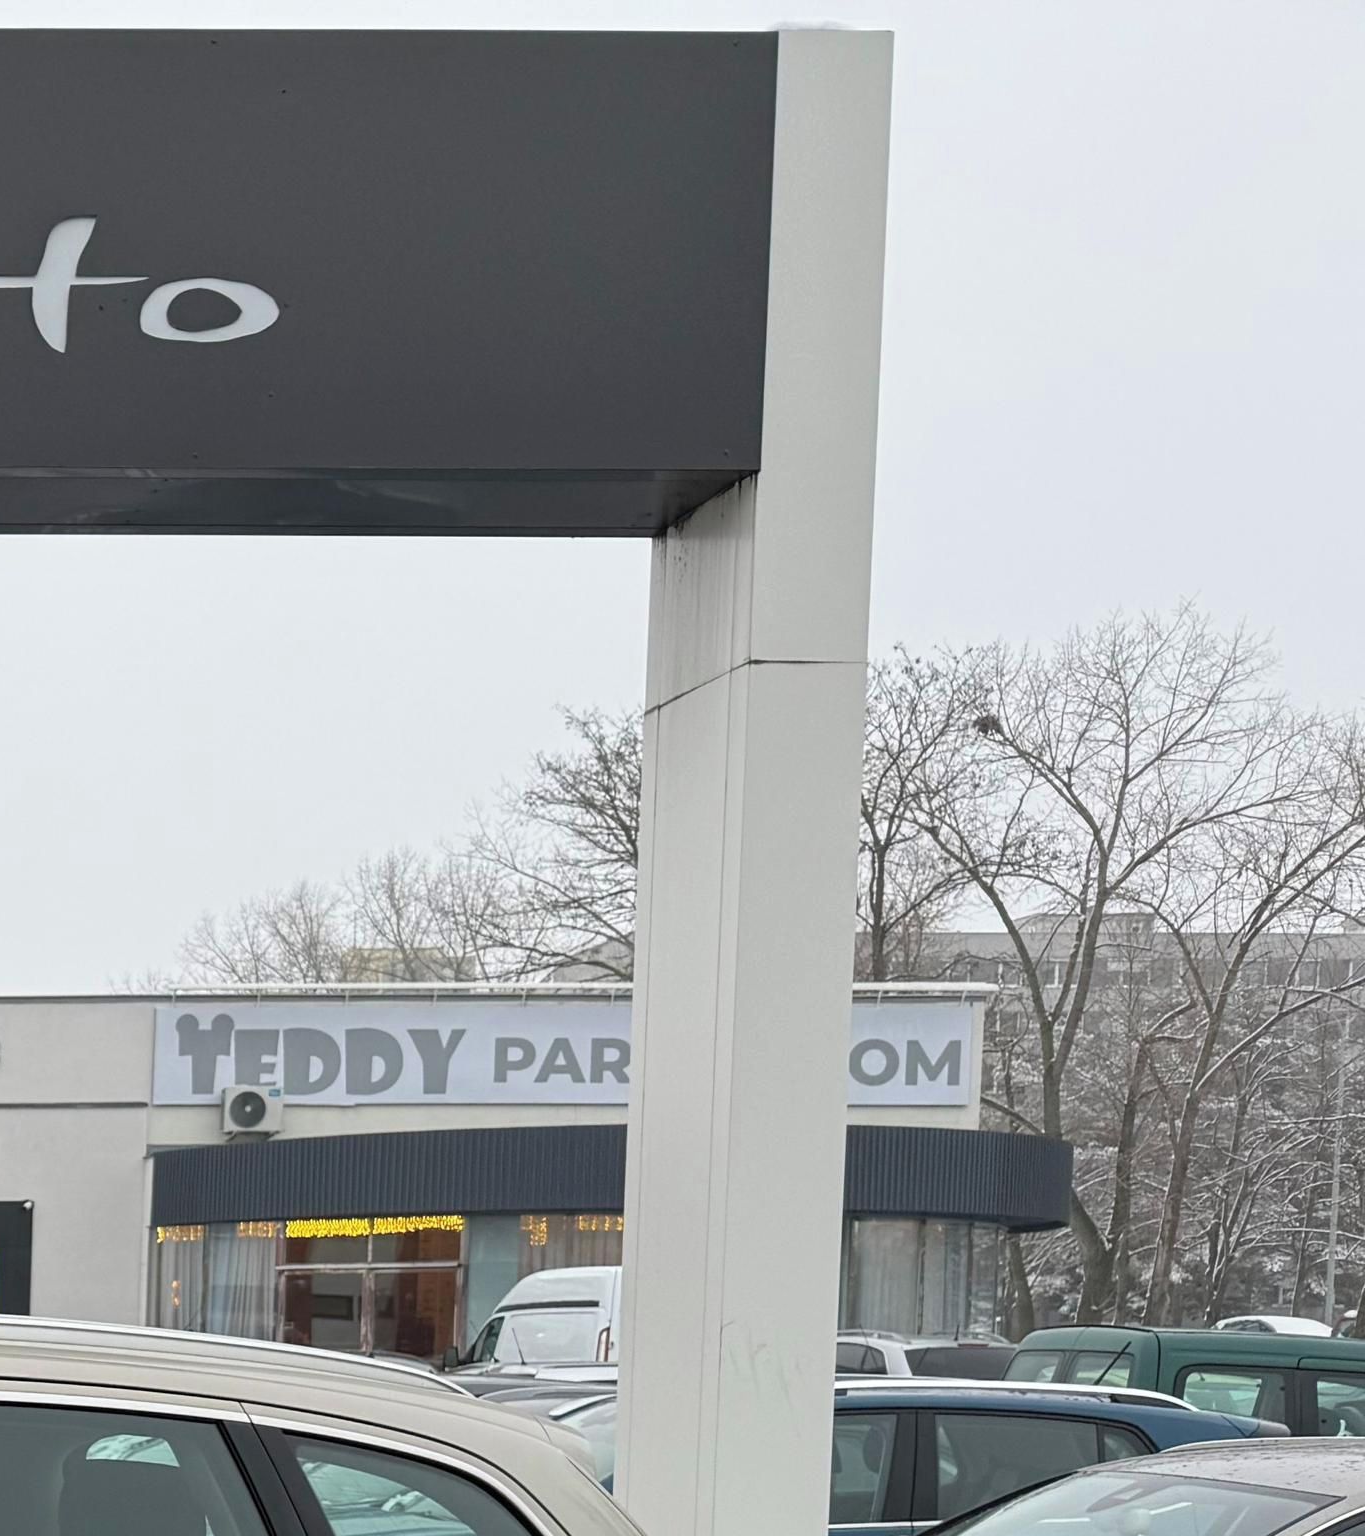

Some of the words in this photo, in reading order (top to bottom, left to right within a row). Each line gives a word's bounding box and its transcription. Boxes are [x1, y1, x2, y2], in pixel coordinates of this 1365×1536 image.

[175, 1013, 467, 1096] TEDDY
[493, 1037, 630, 1084] PAR
[849, 1038, 962, 1087] OM
